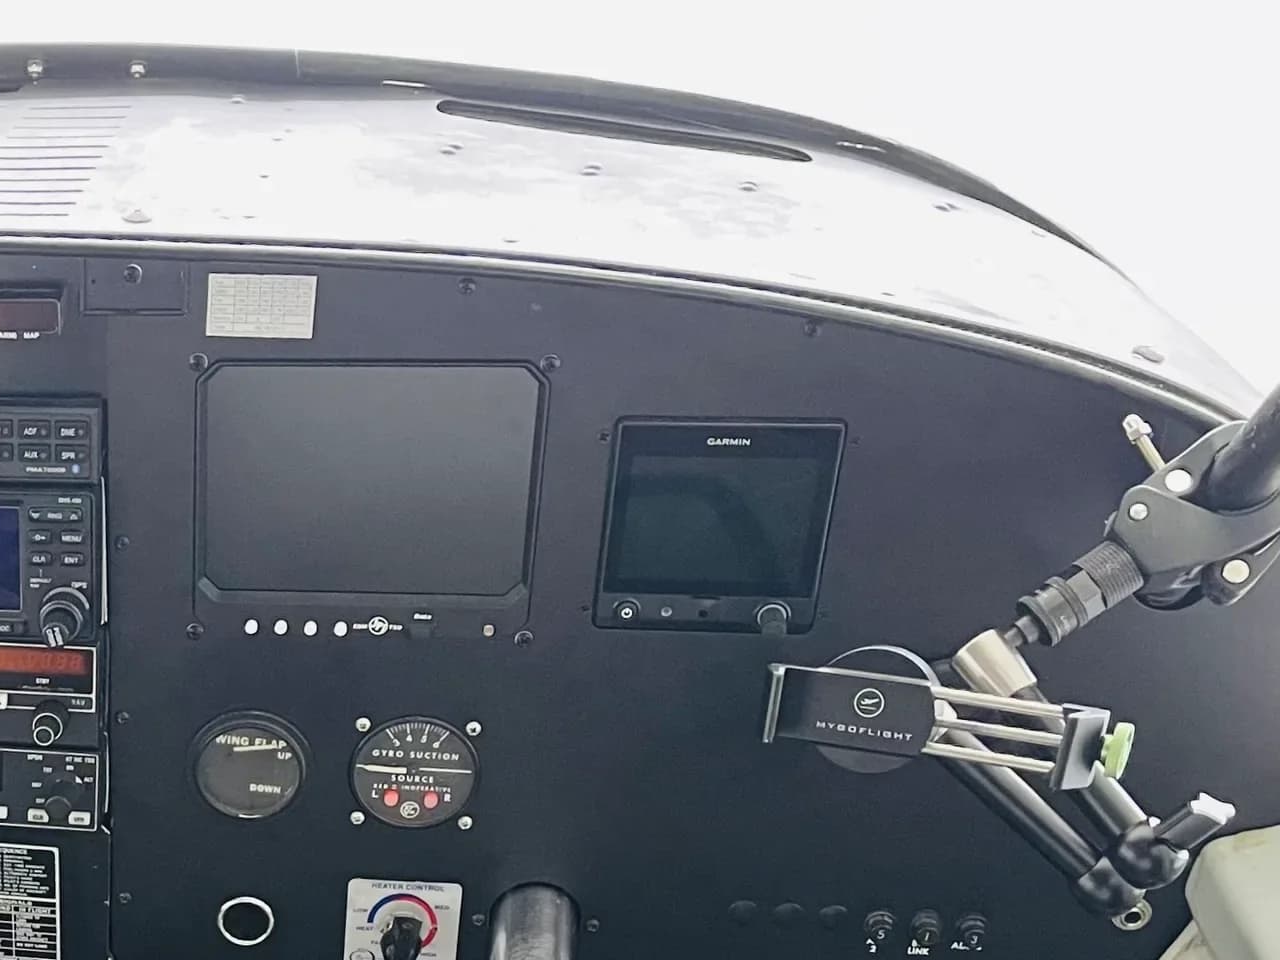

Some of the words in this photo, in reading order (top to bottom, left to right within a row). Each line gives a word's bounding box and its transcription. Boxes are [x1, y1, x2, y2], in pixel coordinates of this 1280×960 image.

[23, 331, 40, 340] MAP
[707, 437, 751, 446] GARMIN
[816, 720, 913, 741] MYGOFLIGHT
[254, 736, 287, 749] FLAP
[392, 738, 400, 747] 3
[406, 734, 412, 742] 4
[421, 735, 428, 743] 5
[277, 752, 292, 760] UP
[372, 749, 404, 758] GYRO
[409, 751, 459, 760] SUCTION
[391, 775, 434, 784] SOURCE
[249, 784, 281, 793] DOWN
[401, 785, 451, 793] INOPERATIVE
[372, 790, 379, 798] L
[444, 793, 451, 802] R
[371, 882, 404, 890] HEATER
[869, 945, 877, 953] 2
[907, 947, 930, 955] LINK
